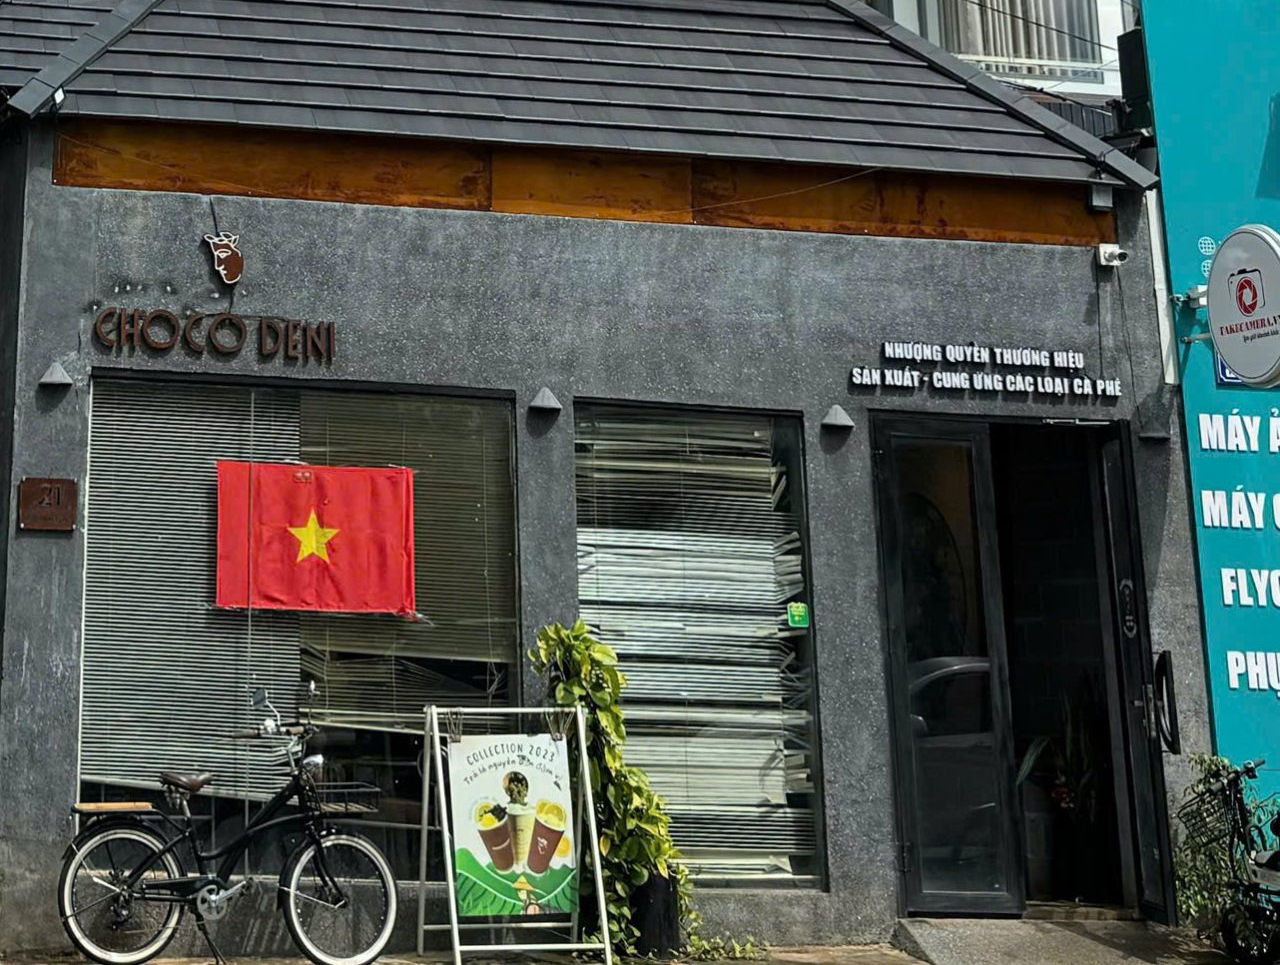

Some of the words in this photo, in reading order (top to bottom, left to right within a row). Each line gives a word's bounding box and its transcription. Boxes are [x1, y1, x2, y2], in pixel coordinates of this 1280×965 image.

[260, 316, 337, 360] DENI
[884, 341, 942, 363] NHƯỢNG
[993, 347, 1050, 367] THƯƠNG
[1053, 350, 1084, 373] HIỆU
[932, 371, 970, 389] CUNG
[1005, 373, 1035, 393] CÁC
[1037, 376, 1069, 396] LOẠI
[1096, 378, 1122, 397] PHÊ
[1199, 408, 1261, 452] MÁY
[1201, 485, 1266, 529] MÁY
[466, 743, 523, 766] COLLECTION
[528, 745, 555, 762] 2023
